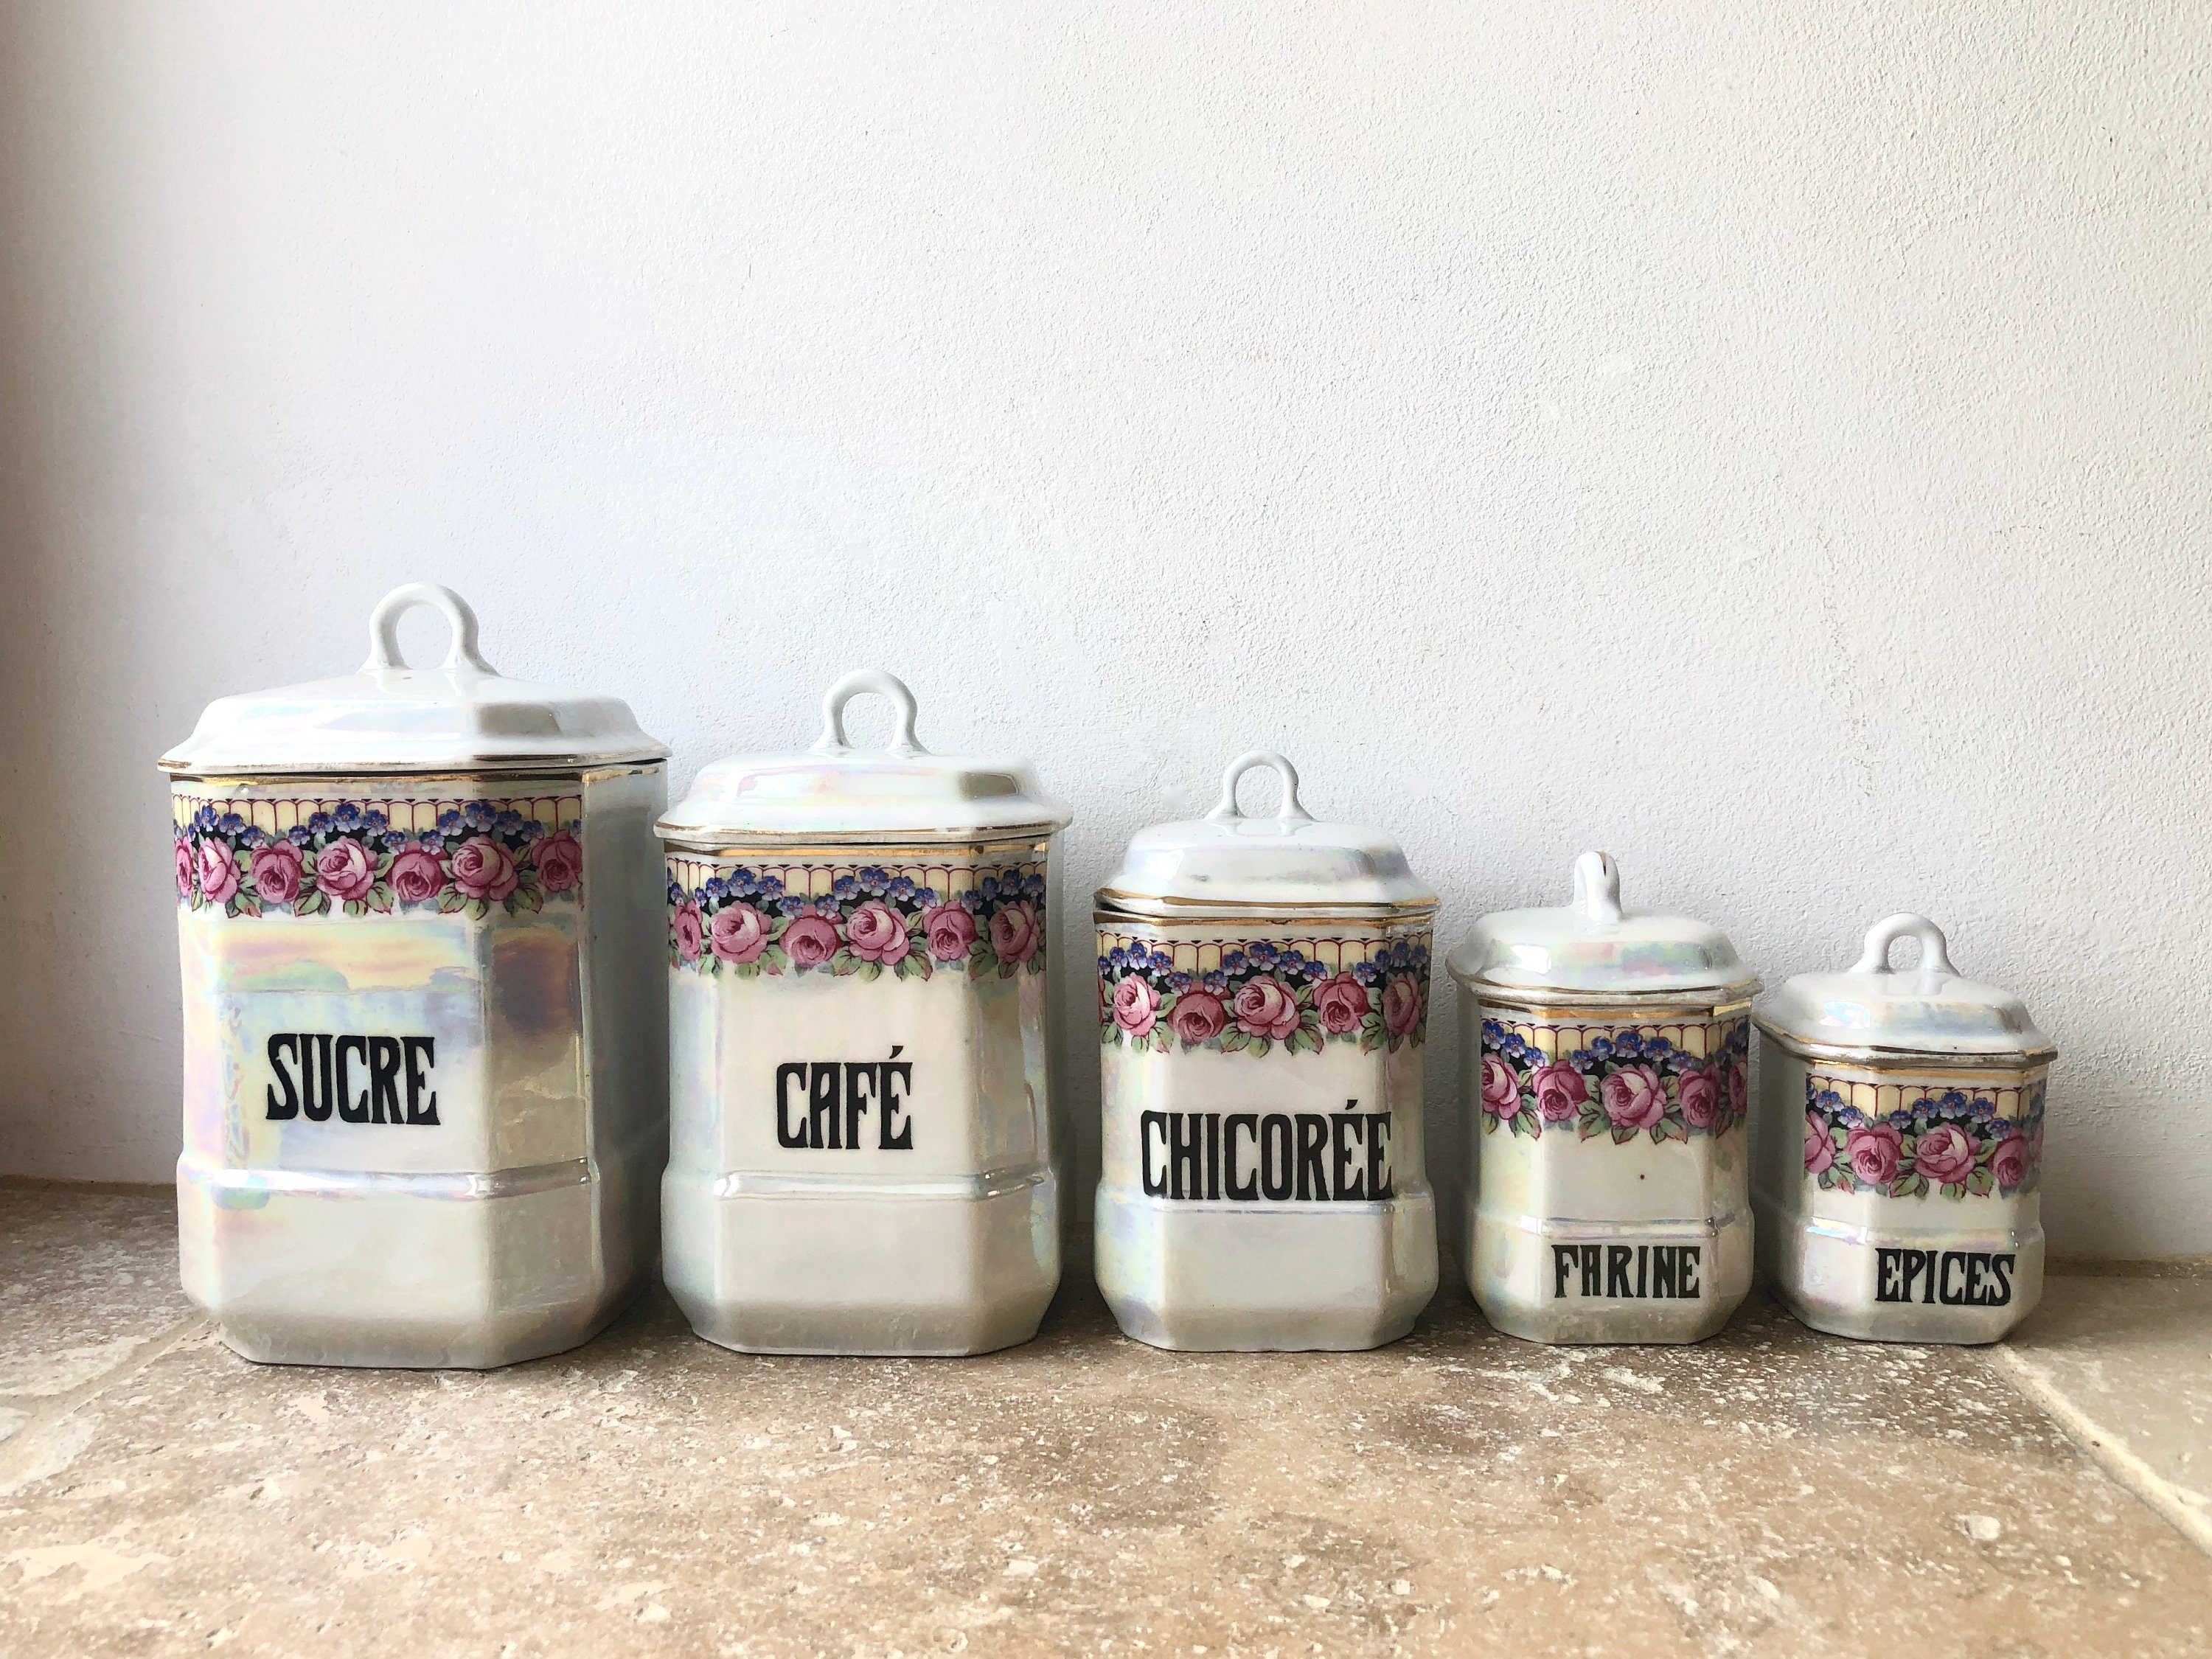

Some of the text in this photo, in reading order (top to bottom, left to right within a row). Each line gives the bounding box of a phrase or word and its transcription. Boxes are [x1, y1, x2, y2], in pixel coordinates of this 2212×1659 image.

[265, 1033, 441, 1126] SUCRE
[776, 1045, 914, 1150] CAFÉ
[1140, 1099, 1395, 1202] CHICORÉE
[1551, 1244, 1701, 1299] FARINE
[1874, 1248, 2017, 1307] EPICES
